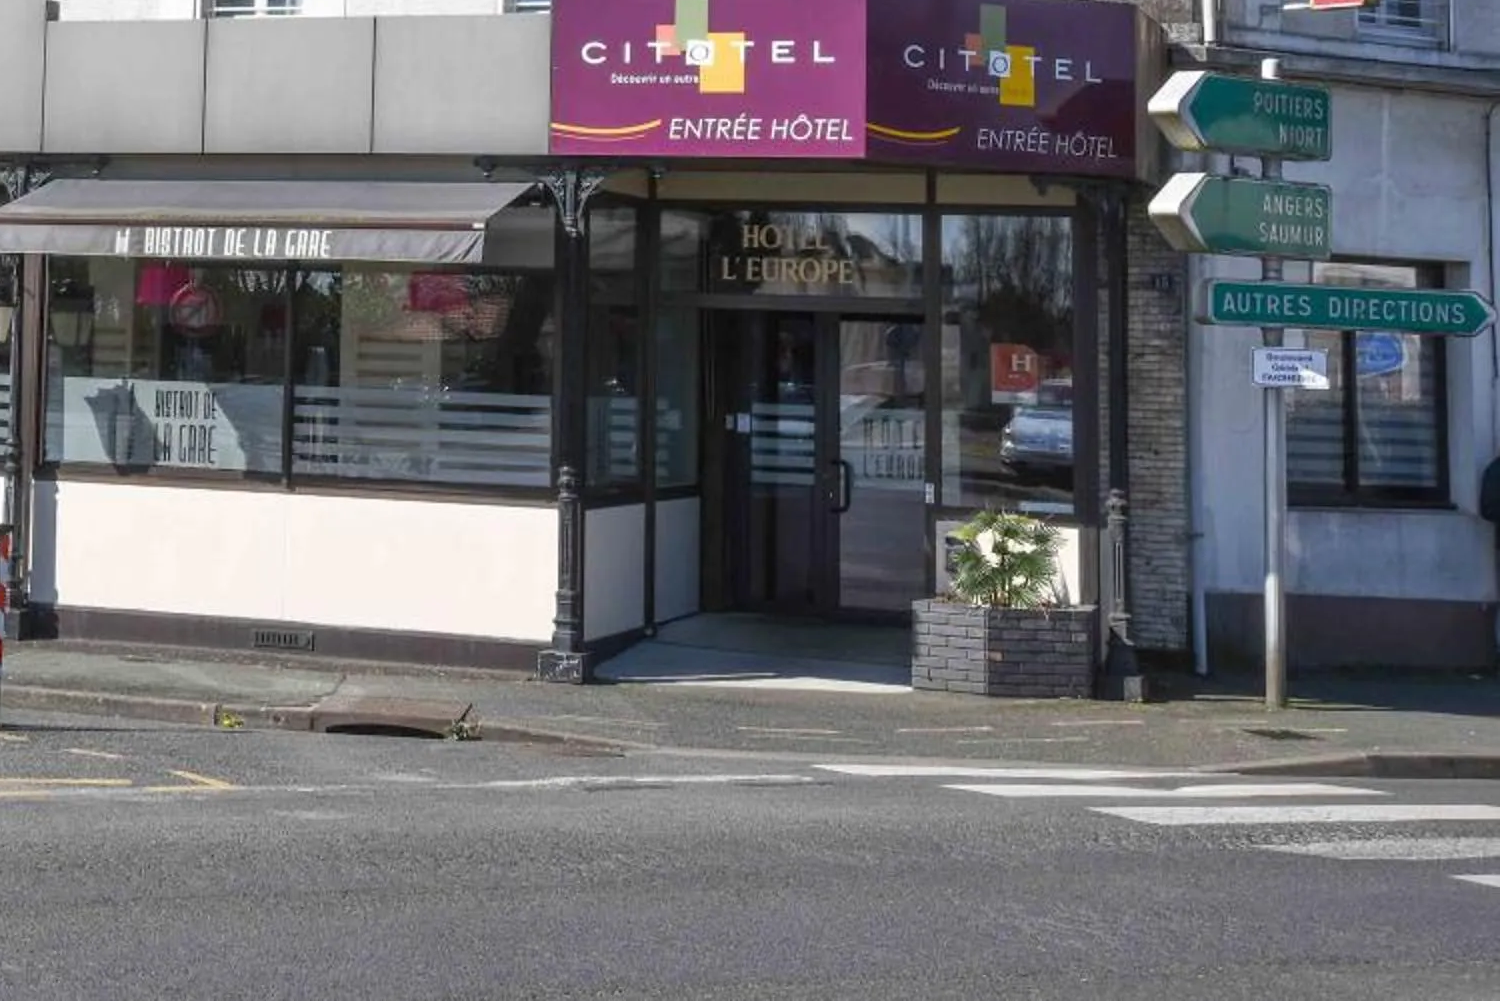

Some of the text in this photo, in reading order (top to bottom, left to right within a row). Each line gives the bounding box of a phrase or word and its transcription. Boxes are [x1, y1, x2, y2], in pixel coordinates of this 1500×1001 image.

[581, 39, 835, 66] CITOTEL
[903, 45, 1102, 83] CITOTEL
[1253, 91, 1324, 120] POITIERS
[668, 113, 853, 140] ENTRÉE HÔTEL
[1279, 122, 1323, 148] NIORT
[976, 126, 1118, 158] ENTRÉE HÔTEL
[1263, 194, 1323, 218] ANGERS
[145, 227, 332, 257] BISTROT DE LA GARE
[1259, 222, 1324, 247] SAUMUR
[1223, 292, 1466, 324] AUTRES DIRECTIONS
[1011, 354, 1031, 372] H
[155, 389, 198, 419] BISTROT
[179, 423, 217, 464] GARE
